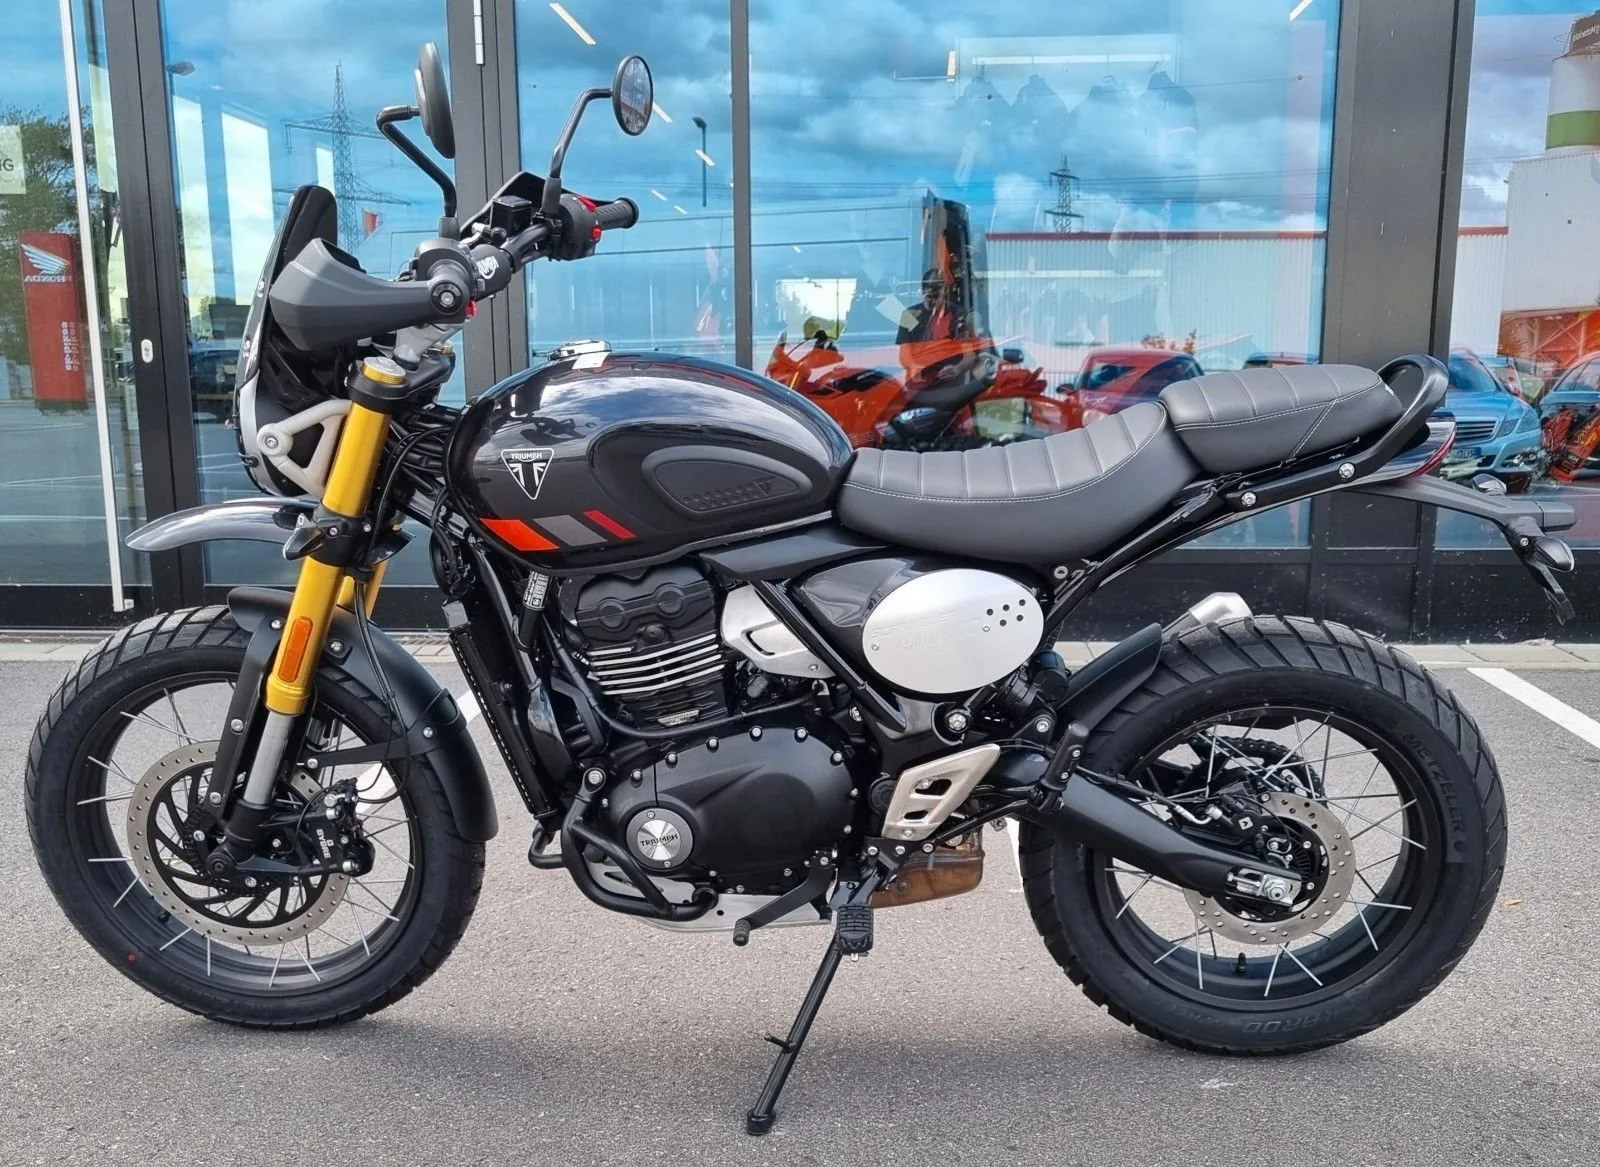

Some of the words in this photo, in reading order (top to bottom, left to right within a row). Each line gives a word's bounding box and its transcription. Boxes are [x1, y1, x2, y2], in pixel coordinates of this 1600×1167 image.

[510, 452, 543, 462] TRIUMPH
[1402, 732, 1466, 832] METZELER
[640, 833, 679, 847] TRIUMPH
